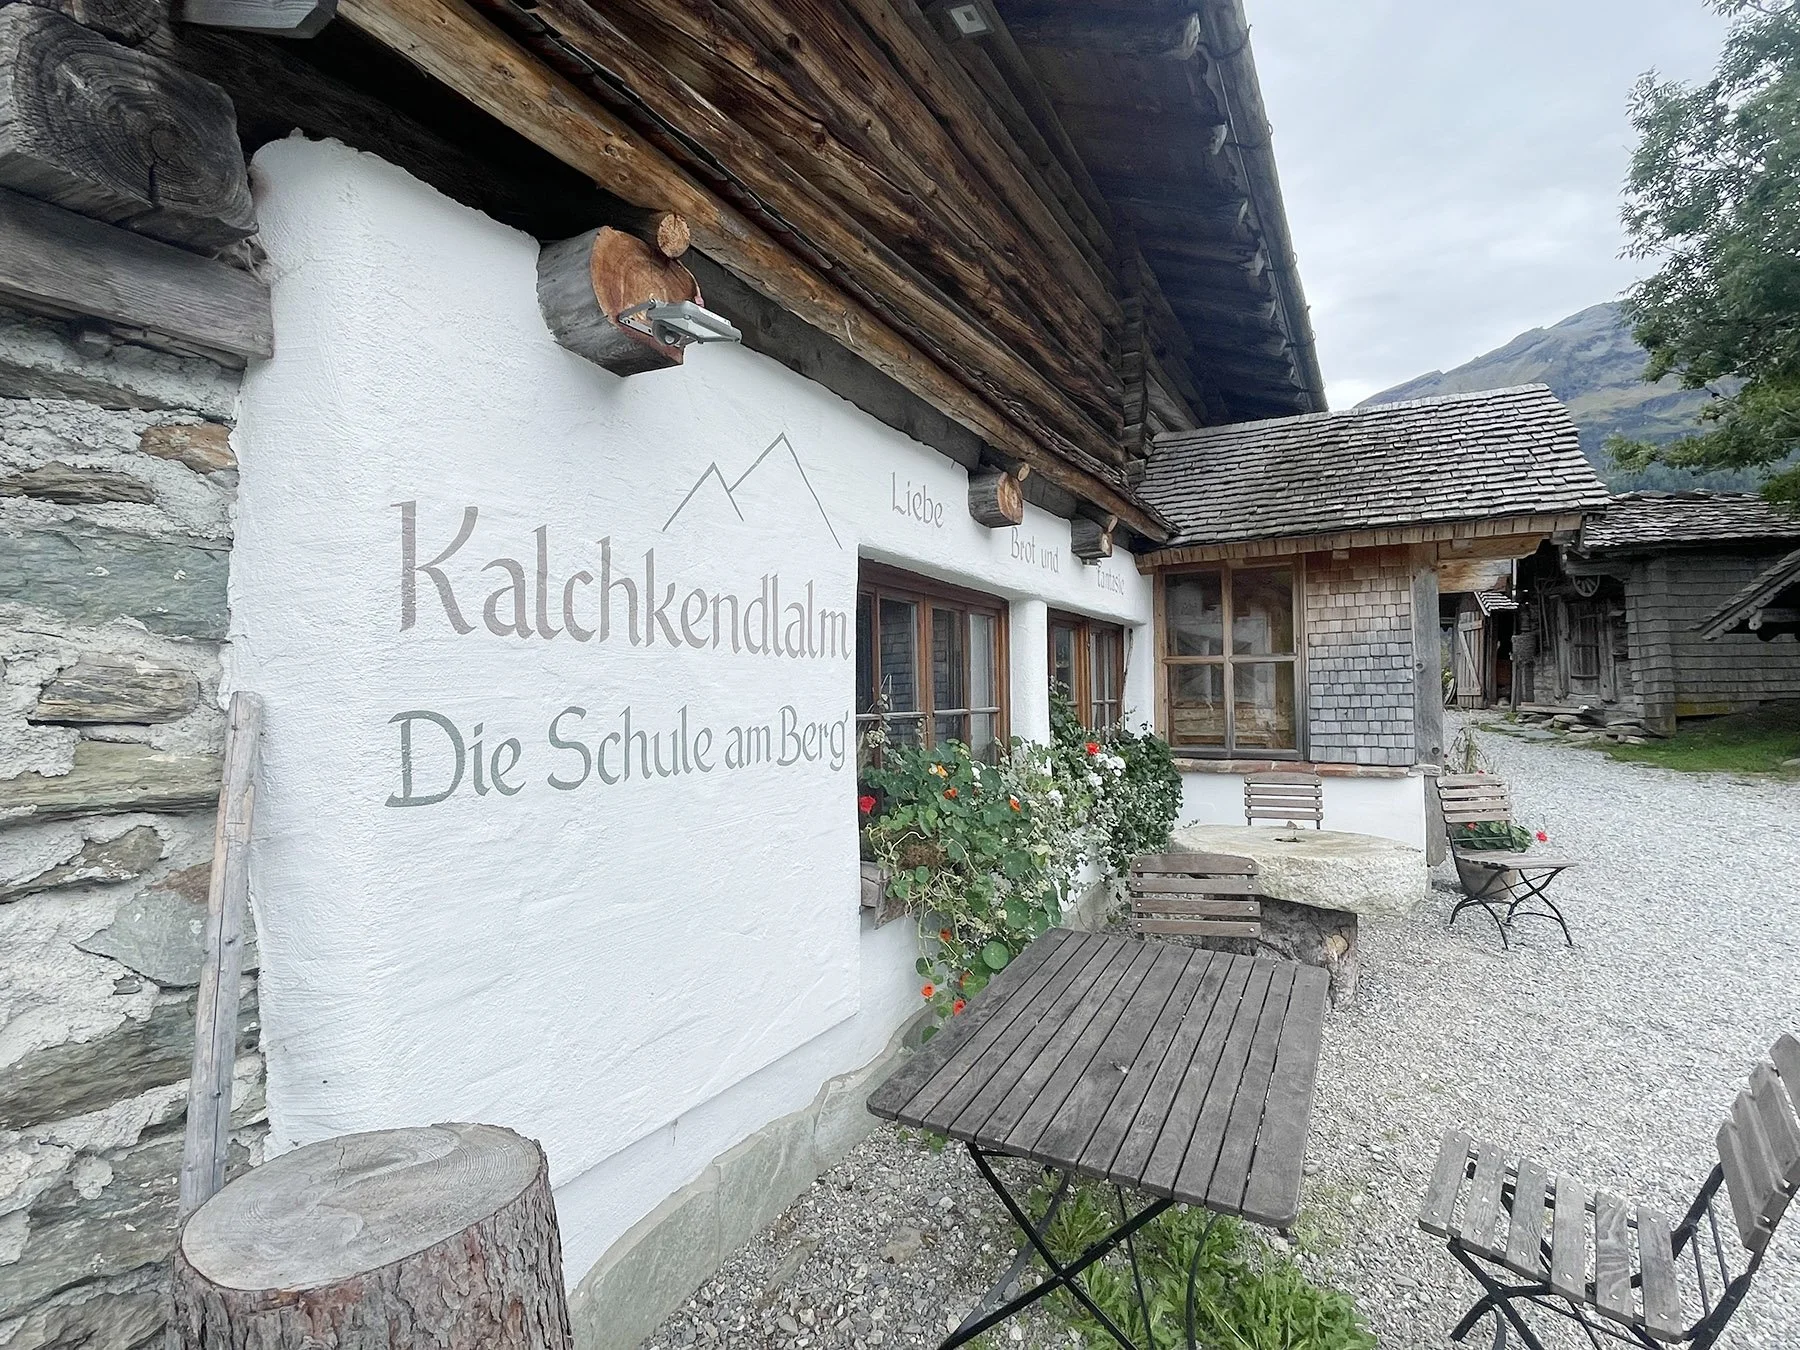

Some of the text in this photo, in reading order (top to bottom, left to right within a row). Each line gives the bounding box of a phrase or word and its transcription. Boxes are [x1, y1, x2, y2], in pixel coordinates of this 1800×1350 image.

[890, 471, 944, 529] Liebe
[1011, 526, 1036, 565] Brot
[1041, 546, 1059, 573] und
[390, 499, 852, 661] Kalchkendlalm
[384, 704, 849, 808] Die Schule am Berg
